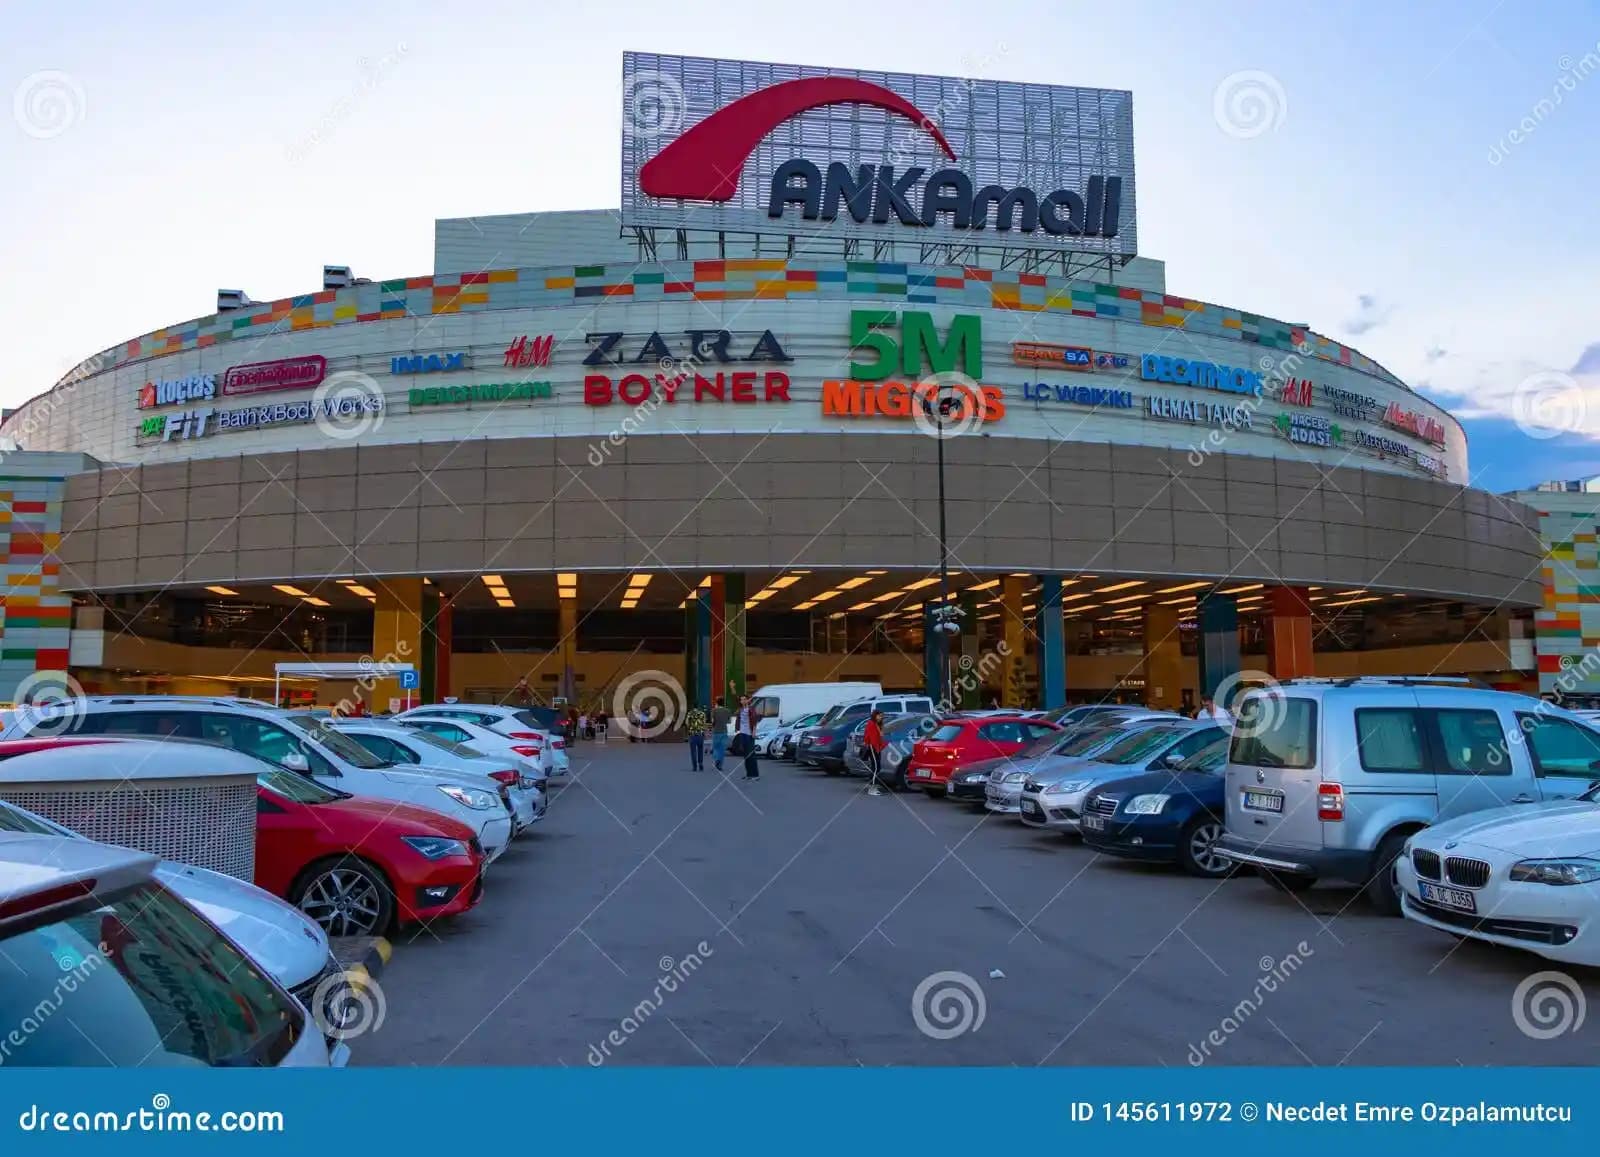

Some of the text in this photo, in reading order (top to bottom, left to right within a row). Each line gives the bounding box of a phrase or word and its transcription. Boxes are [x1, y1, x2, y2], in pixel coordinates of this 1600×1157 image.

[768, 158, 1121, 239] ANKAmall
[504, 335, 553, 368] H&M
[583, 329, 794, 365] ZARA
[850, 309, 982, 381] 5M
[392, 352, 464, 376] IMAX
[584, 371, 792, 406] BOYNER
[1024, 382, 1050, 401] LC
[220, 395, 383, 428] Bath & Body Works
[1150, 395, 1203, 421] KEMAL
[403, 672, 415, 688] P
